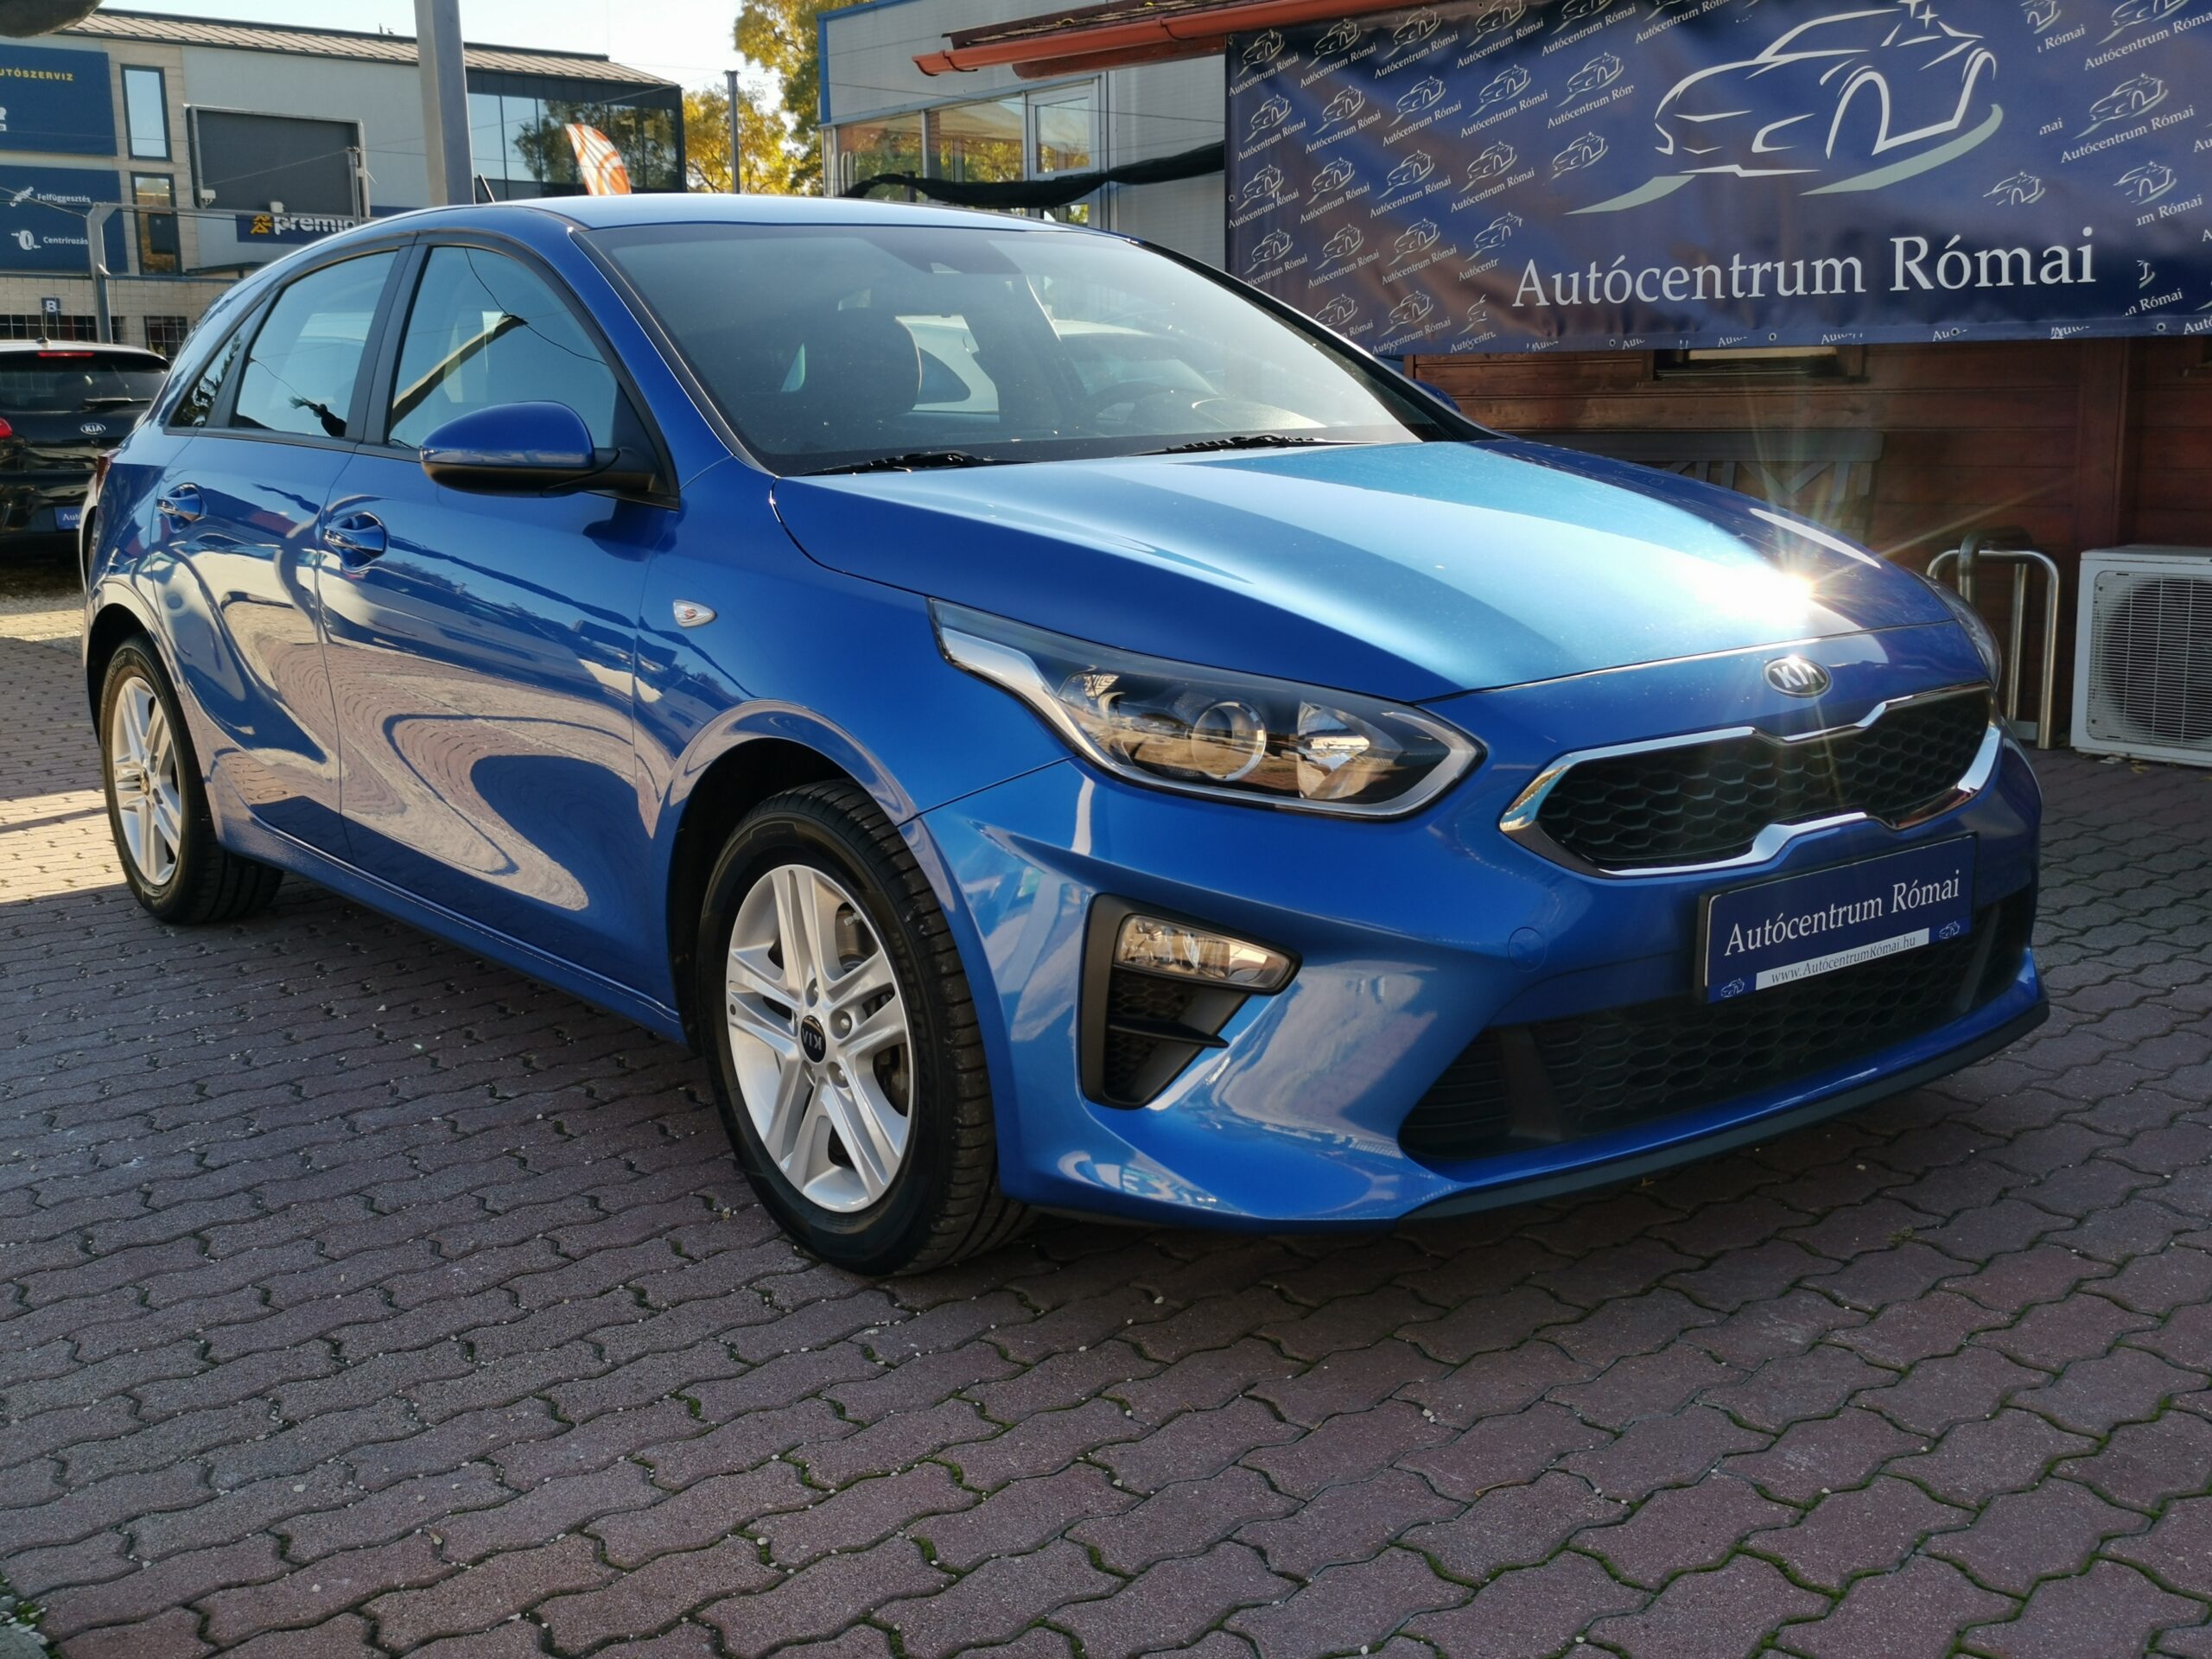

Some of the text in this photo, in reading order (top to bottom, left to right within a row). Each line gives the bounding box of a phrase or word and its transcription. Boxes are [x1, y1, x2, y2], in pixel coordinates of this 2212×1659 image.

[2044, 24, 2086, 50] Római
[37, 193, 91, 203] Felfüggesztés
[2158, 194, 2203, 218] Római
[1512, 226, 2097, 307] Autócentrum Római
[46, 300, 57, 313] B
[2139, 288, 2183, 311] Római
[1771, 661, 1826, 689] KIA
[1725, 868, 1960, 957] Autócentrum Római
